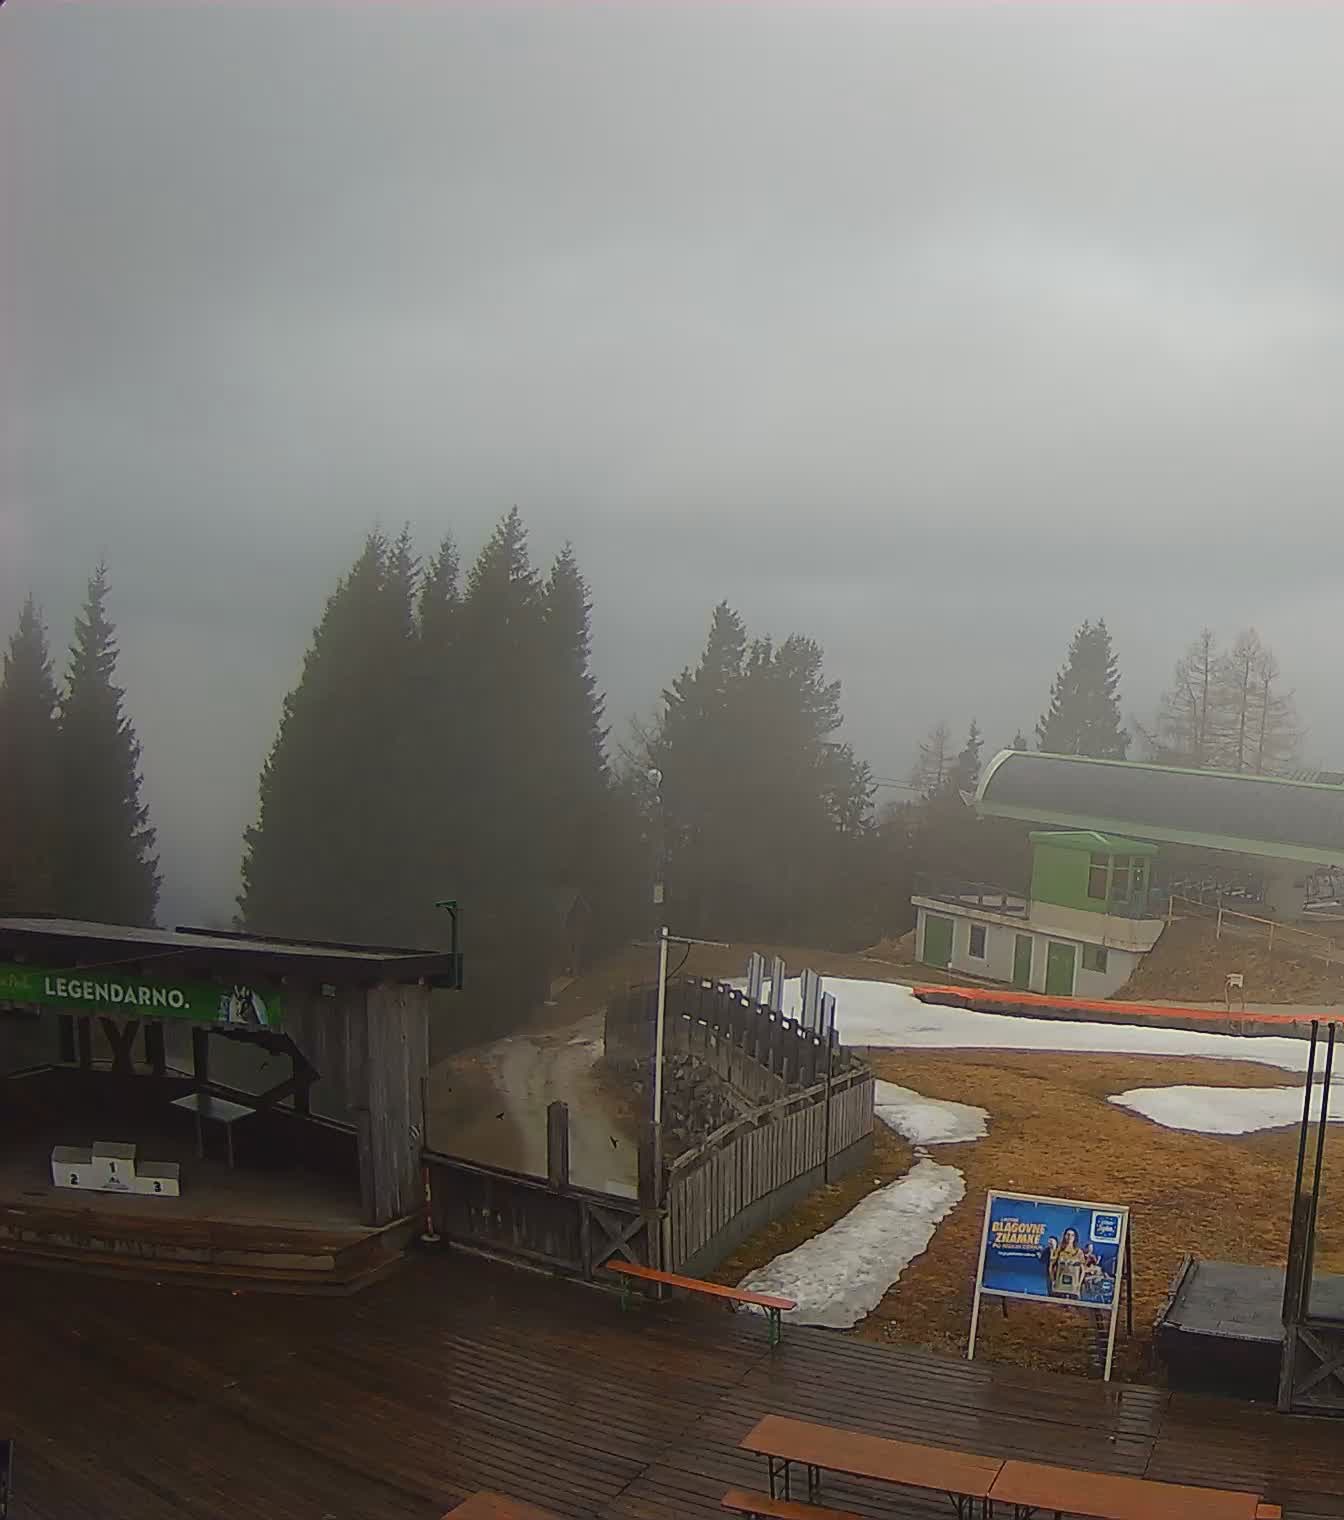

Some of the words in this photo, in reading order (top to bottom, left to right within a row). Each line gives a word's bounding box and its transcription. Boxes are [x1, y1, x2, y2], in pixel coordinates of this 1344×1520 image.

[45, 977, 190, 1009] LEGENDARNO.
[109, 1162, 116, 1173] 1
[70, 1173, 78, 1185] 2
[153, 1181, 162, 1192] 3
